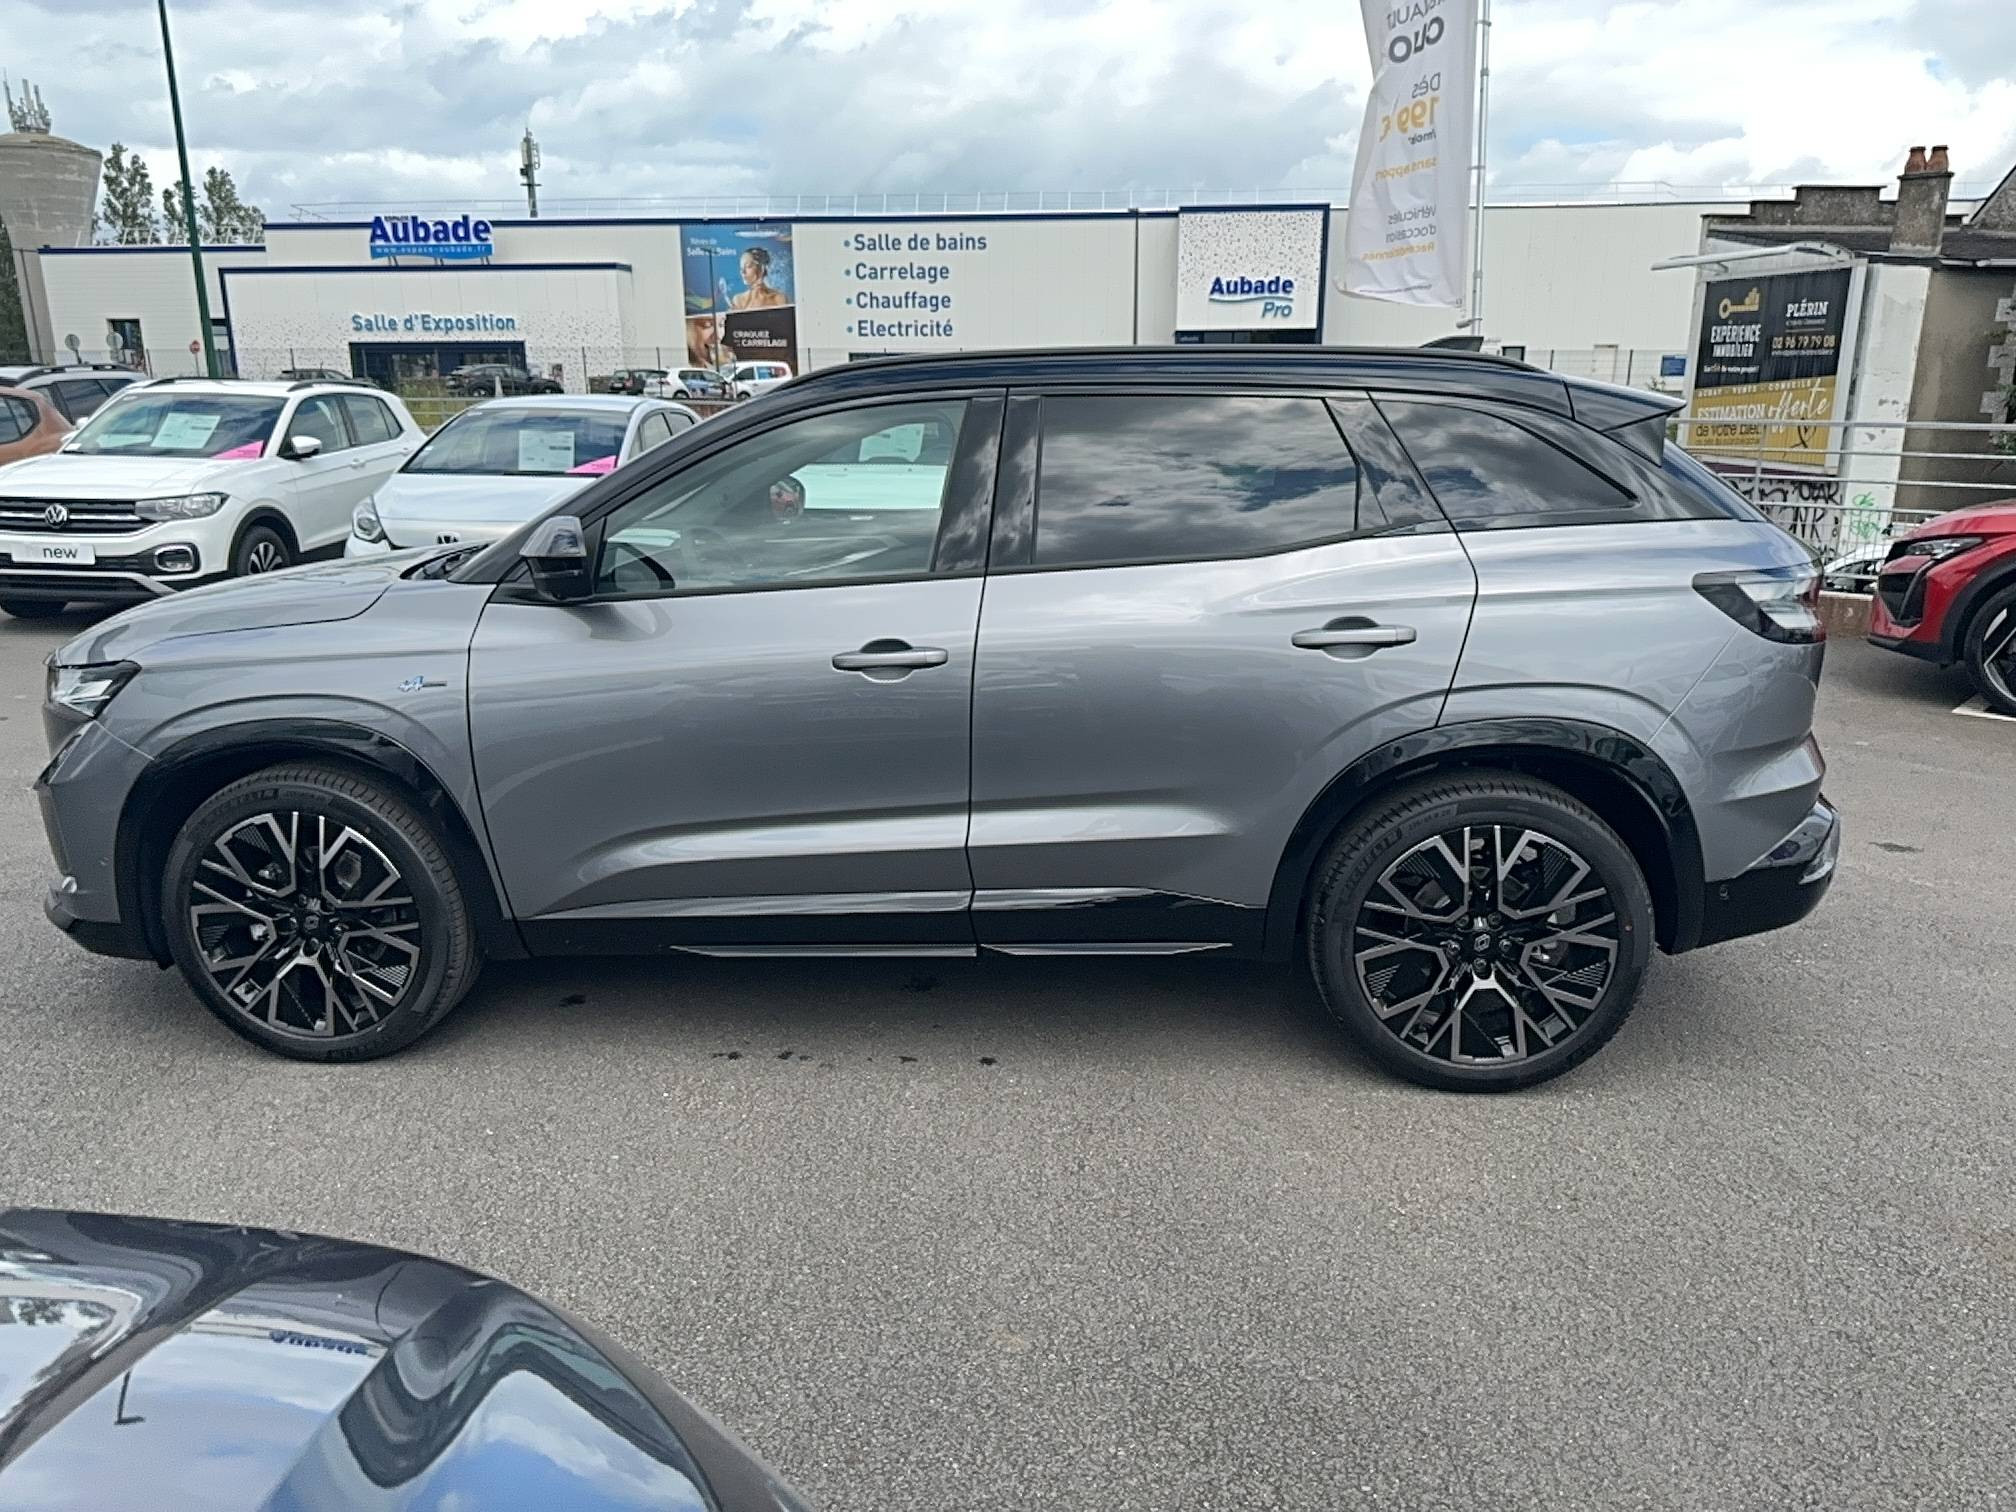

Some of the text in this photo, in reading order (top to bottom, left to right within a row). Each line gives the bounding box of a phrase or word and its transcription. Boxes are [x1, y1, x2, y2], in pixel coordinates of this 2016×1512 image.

[370, 214, 492, 243] Aubade
[854, 232, 987, 251] Salle de bains
[855, 262, 950, 284] Carrelage
[1210, 276, 1295, 296] Aubade
[856, 291, 951, 313] Chauffage
[1262, 302, 1293, 318] Pro
[1786, 298, 1829, 318] PLÉRIN
[352, 314, 516, 335] Salle d'Exposition
[858, 318, 953, 337] Electricité
[43, 547, 78, 559] new
